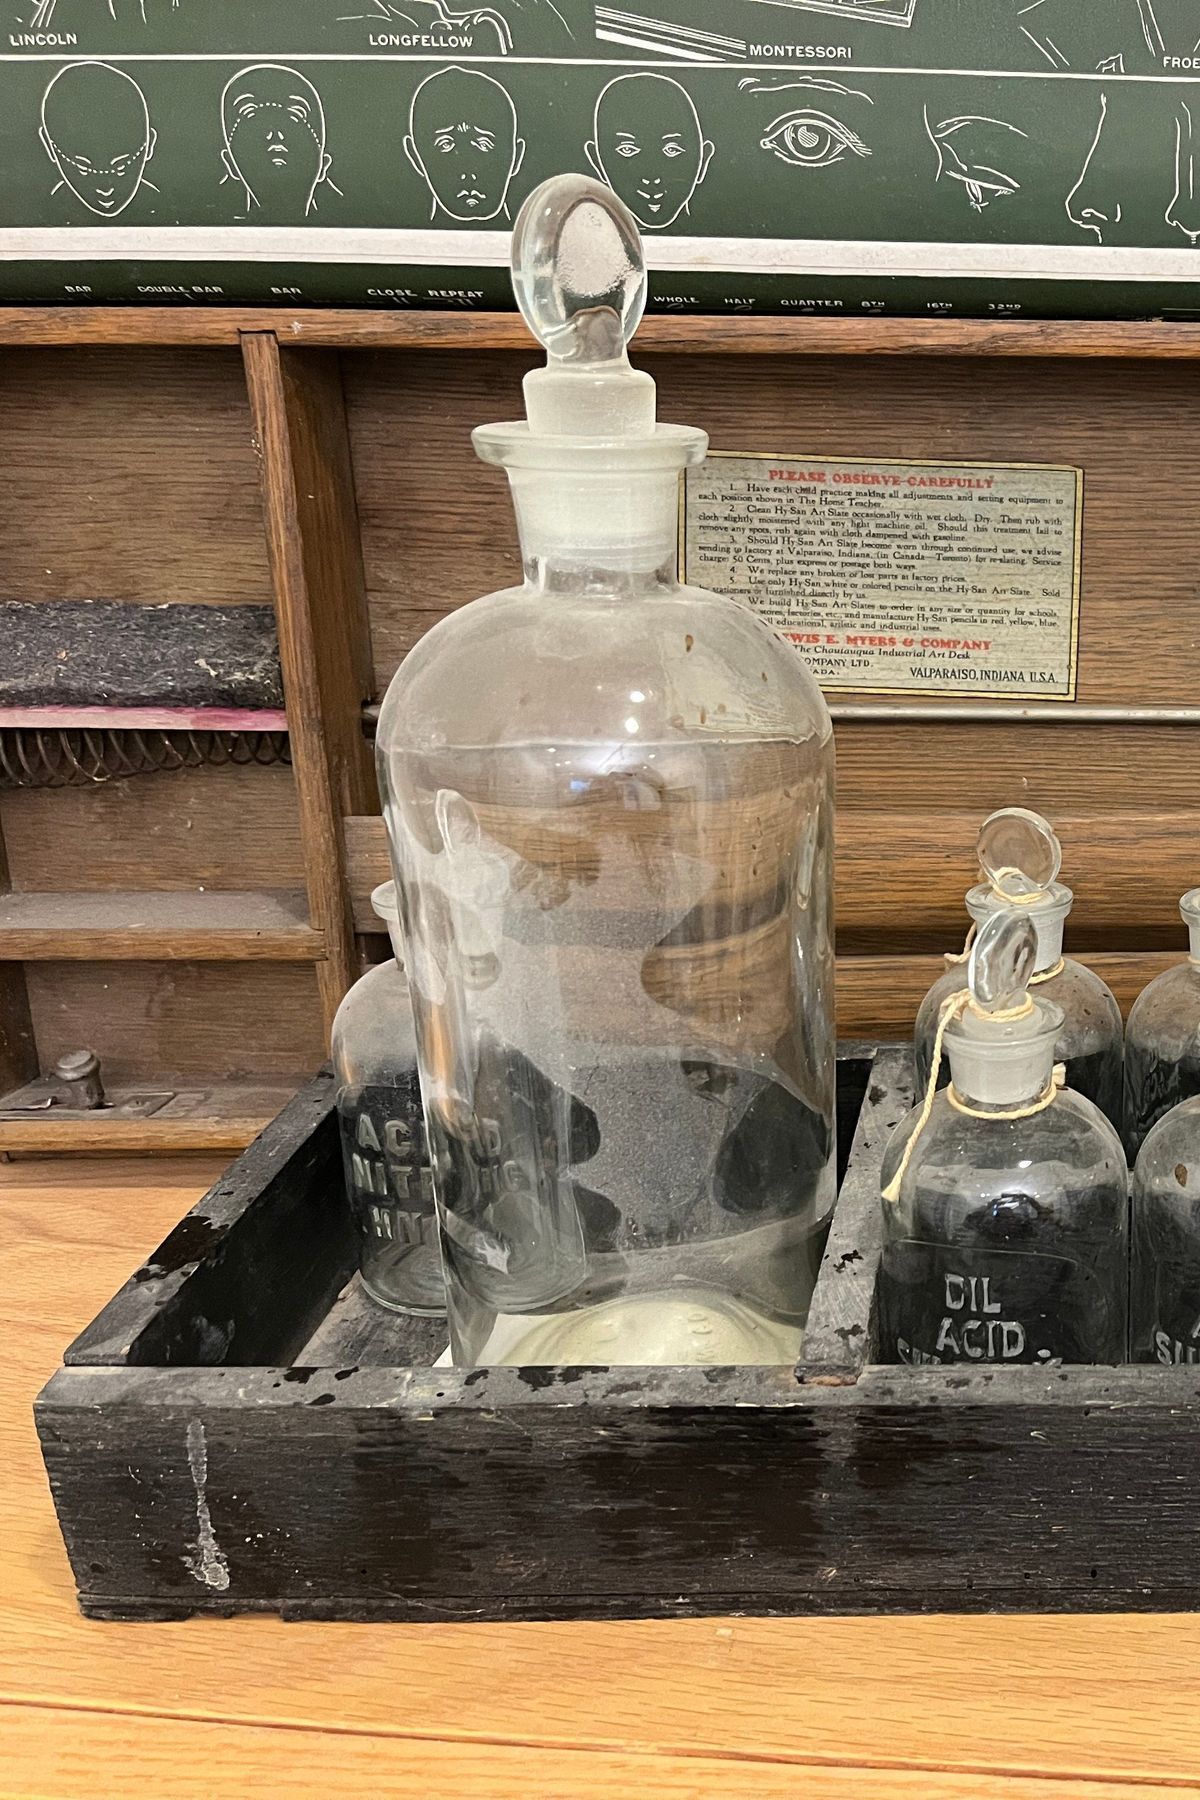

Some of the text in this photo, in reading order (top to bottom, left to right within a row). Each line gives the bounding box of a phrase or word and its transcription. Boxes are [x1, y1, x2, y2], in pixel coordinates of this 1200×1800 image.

[9, 33, 78, 46] LINCOLN
[369, 34, 474, 48] LONGFELLOW
[749, 44, 852, 59] MONTESSORI
[65, 285, 92, 293] BAR
[137, 285, 189, 293] DOUBLE
[368, 289, 417, 297] CLOSE
[429, 290, 484, 298] REPEAT
[653, 296, 699, 304] WHOLE
[780, 300, 844, 308] QUARTER
[768, 470, 994, 489] PLEASE OBSERVE CAREFULLY
[698, 491, 717, 500] each
[799, 495, 816, 504] The
[819, 496, 844, 506] Home
[848, 497, 884, 507] Teacher.
[747, 483, 770, 493] Have
[773, 484, 792, 494] each
[820, 486, 852, 498] practice
[855, 487, 886, 499] making
[903, 489, 953, 502] adjustments
[957, 491, 973, 501] and
[1008, 494, 1051, 506] equipment
[747, 503, 771, 513] Clean
[810, 506, 826, 515] Art
[827, 507, 849, 516] Slate
[851, 508, 900, 520] occasionally
[903, 510, 922, 519] with
[1025, 515, 1040, 524] rub
[1043, 516, 1062, 525] with
[698, 512, 719, 521] cloth
[723, 513, 752, 524] slightly
[806, 516, 824, 525] with
[831, 519, 845, 528] any
[875, 519, 910, 529] machine
[937, 522, 968, 531] Should
[973, 523, 988, 532] this
[993, 525, 1031, 534] treatment
[698, 524, 728, 532] remove
[731, 525, 745, 534] any
[793, 526, 816, 537] again
[819, 527, 838, 536] with
[841, 528, 863, 537] cloth
[865, 529, 907, 541] dampened
[912, 531, 931, 540] with
[745, 544, 772, 556] factory
[747, 534, 778, 544] Should
[817, 537, 833, 547] Art
[836, 538, 858, 548] Slate
[861, 539, 892, 549] become
[921, 542, 954, 553] through
[957, 543, 998, 553] continued
[776, 555, 794, 567] plus
[873, 559, 892, 569] both
[748, 565, 765, 574] We
[767, 565, 797, 577] replace
[799, 569, 814, 578] any
[817, 567, 846, 577] broken
[911, 571, 939, 583] factory
[748, 575, 766, 585] Use
[767, 576, 785, 588] only
[823, 579, 848, 588] white
[861, 580, 891, 590] colored
[894, 581, 922, 593] pencils
[939, 583, 953, 593] the
[991, 585, 1007, 595] Art
[1042, 587, 1061, 597] Sold
[765, 586, 805, 596] furnished
[748, 596, 765, 605] We
[769, 596, 792, 606] build
[832, 599, 848, 608] Art
[850, 600, 875, 610] Slates
[890, 601, 913, 611] order
[929, 605, 944, 614] any
[977, 605, 1010, 617] quantity
[844, 609, 978, 625] and manufacture pencils
[860, 620, 876, 629] and
[880, 620, 919, 631] industrial
[825, 634, 992, 651] E. MYERS & COMPANY
[793, 643, 971, 659] The Chautauqua Industrial Art Desk
[804, 656, 874, 668] OMPANY LTD.
[1030, 671, 1059, 684] U.S.A.
[944, 1273, 1001, 1313] DIL
[935, 1317, 1026, 1358] ACID
